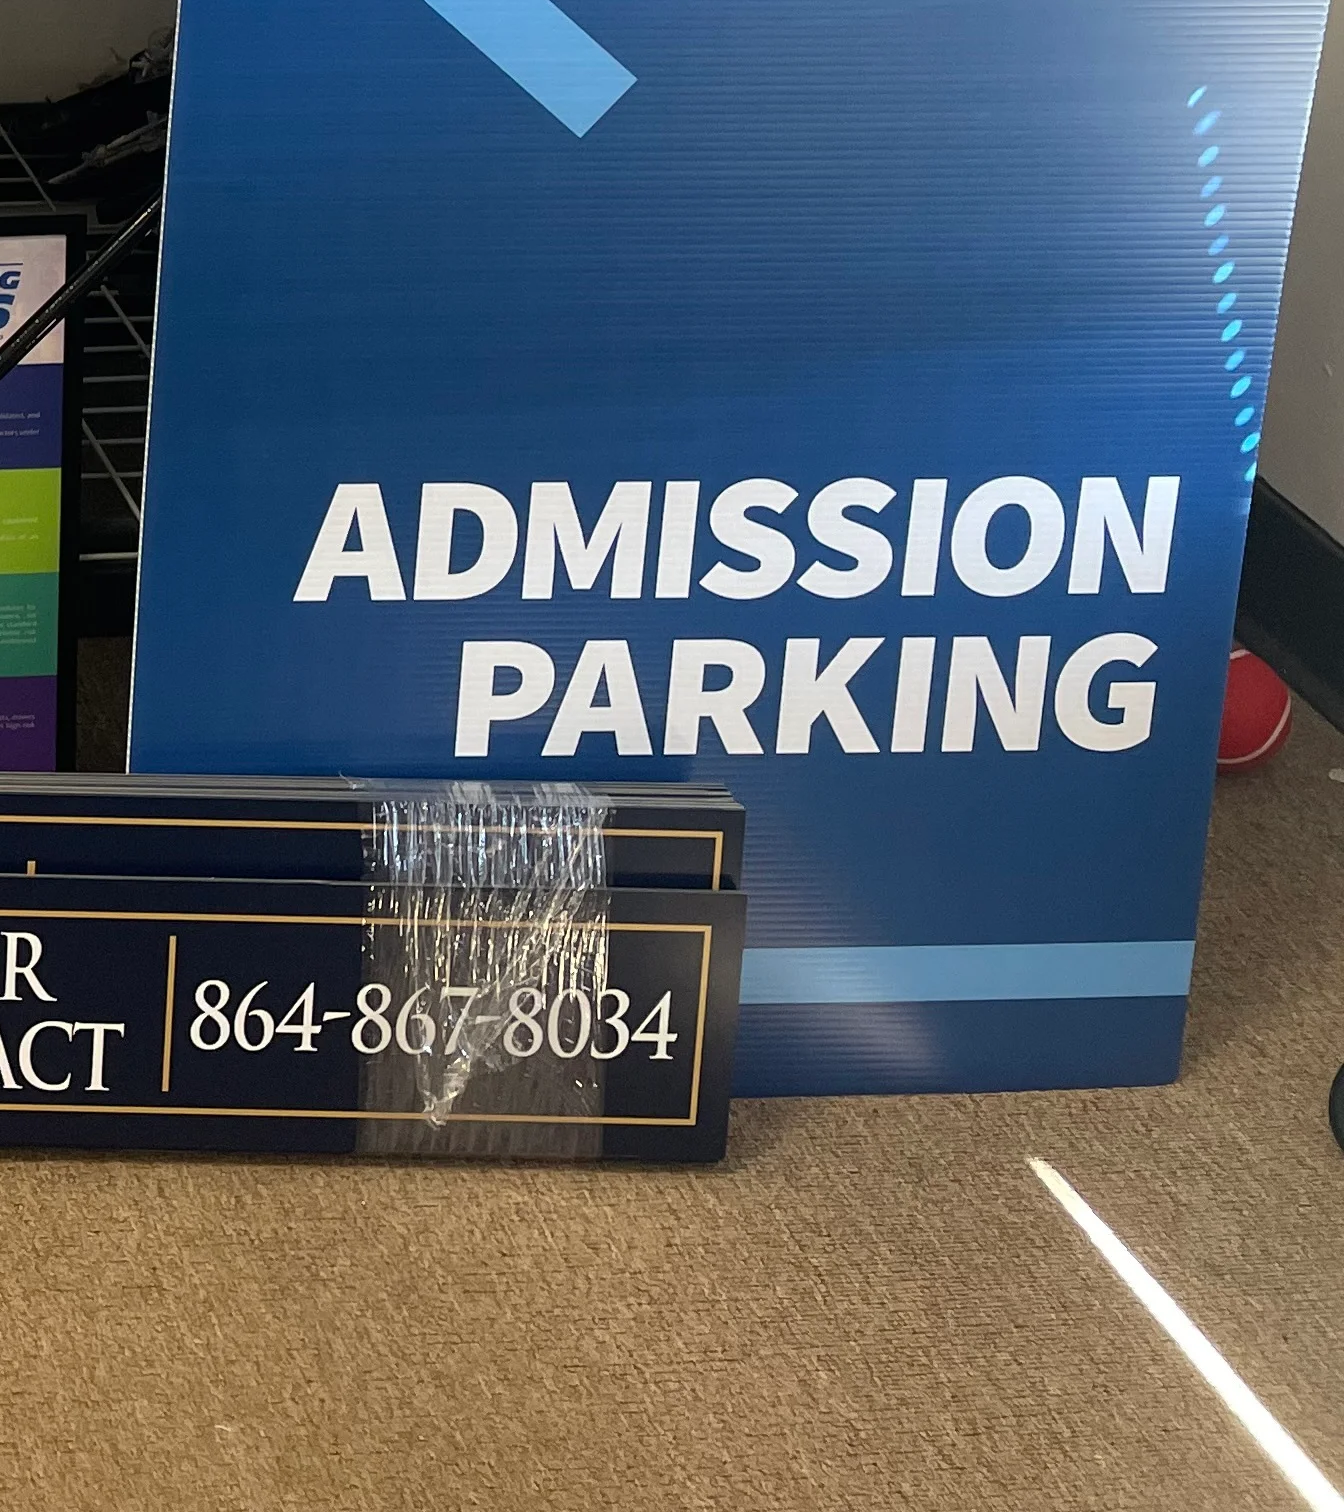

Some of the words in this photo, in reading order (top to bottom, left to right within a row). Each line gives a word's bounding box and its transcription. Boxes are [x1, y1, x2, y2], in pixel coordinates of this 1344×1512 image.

[293, 476, 1180, 601] ADMISSION
[455, 633, 1158, 756] PARKING
[191, 975, 677, 1064] 864-867-8034
